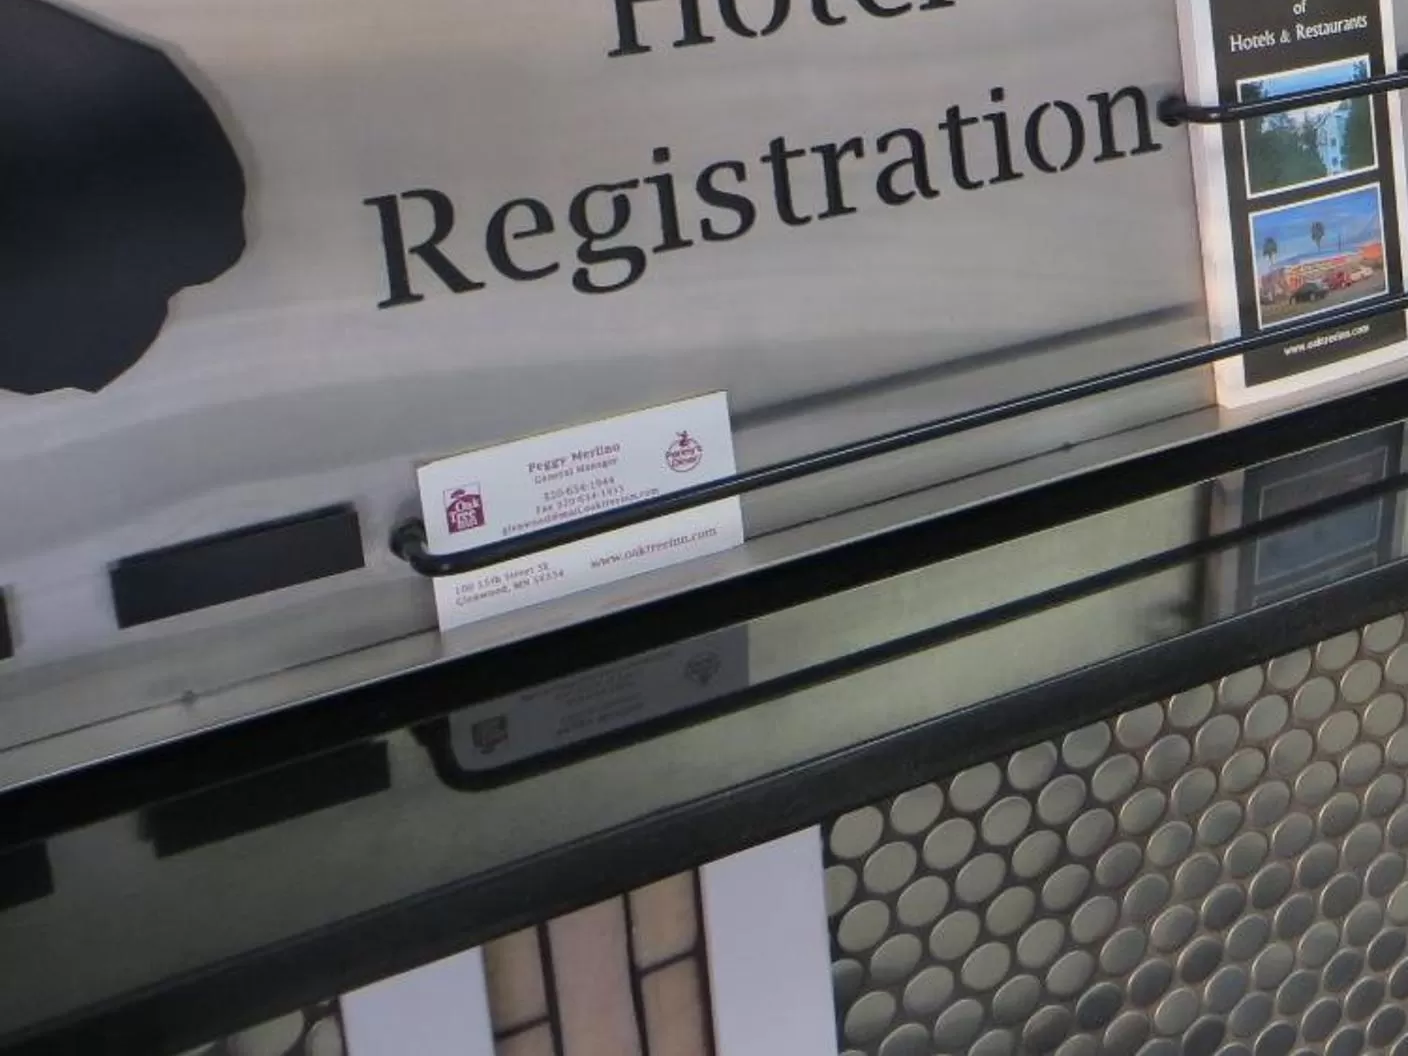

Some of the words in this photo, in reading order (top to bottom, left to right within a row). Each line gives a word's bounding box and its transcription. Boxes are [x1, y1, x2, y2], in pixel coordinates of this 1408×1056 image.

[1230, 30, 1275, 52] Hotels
[1280, 29, 1291, 44] &
[1295, 15, 1368, 41] Restaurants
[363, 81, 1162, 310] Registration
[528, 457, 566, 474] Peggy
